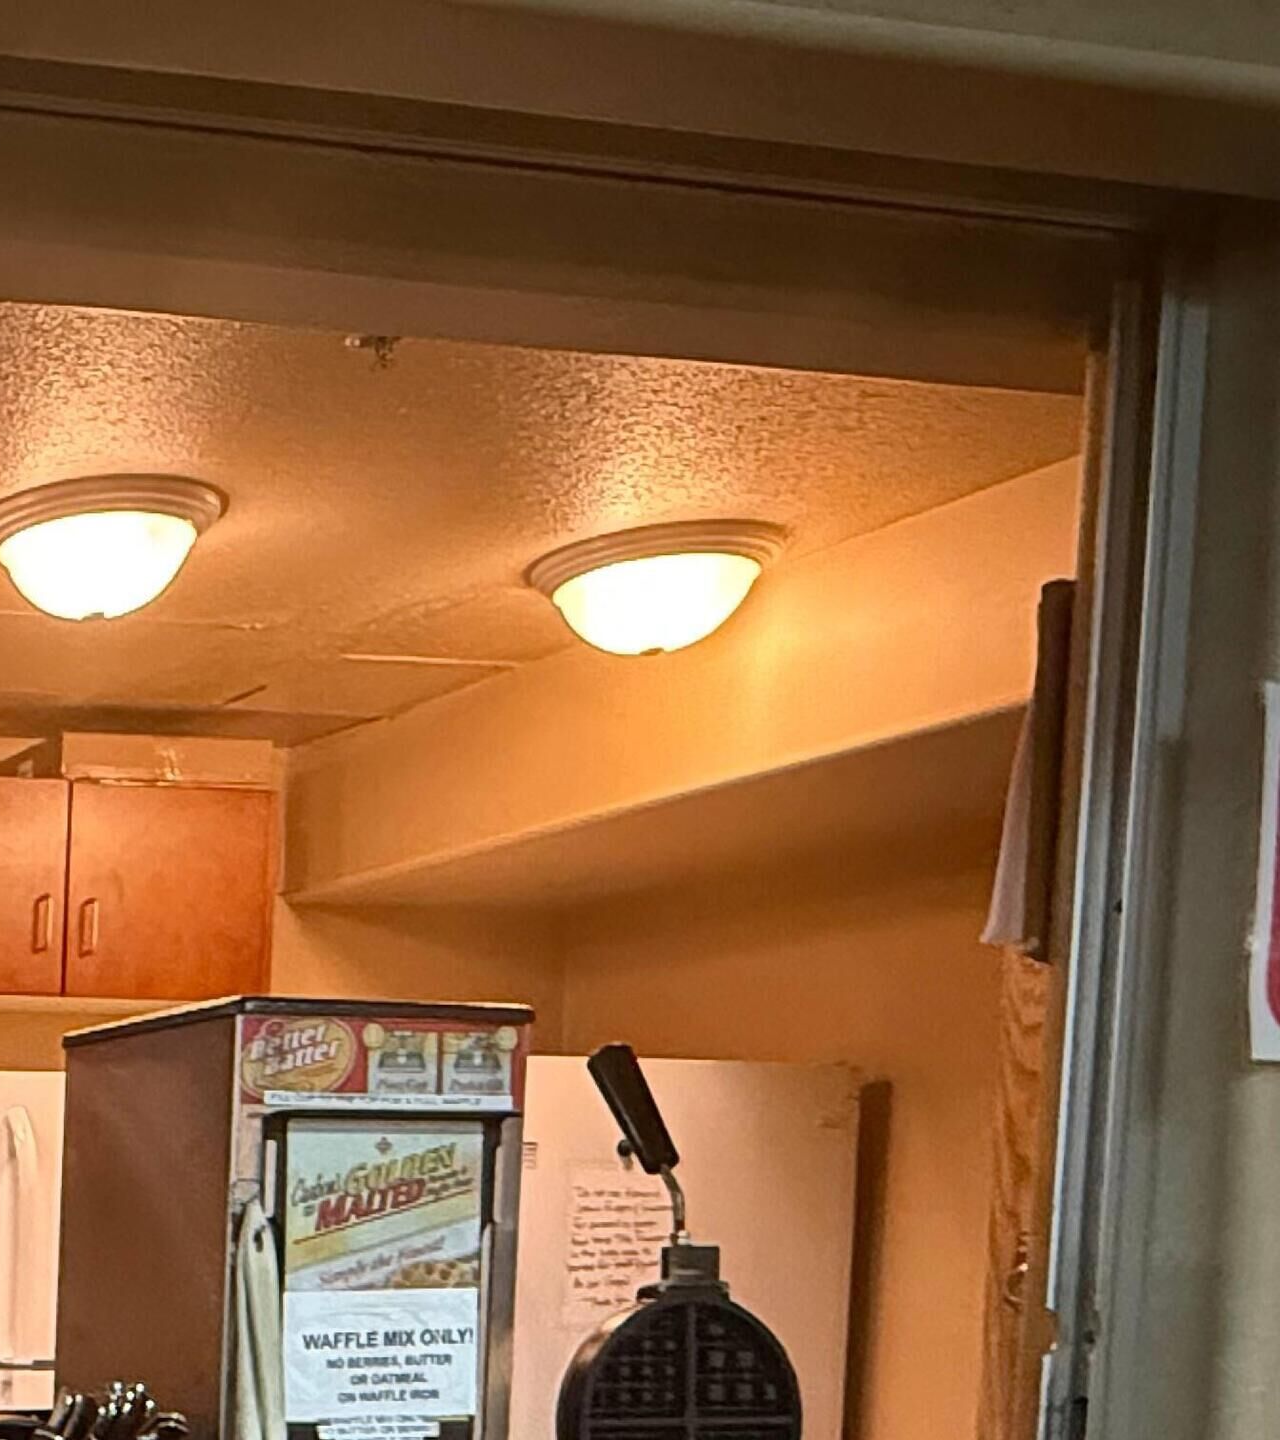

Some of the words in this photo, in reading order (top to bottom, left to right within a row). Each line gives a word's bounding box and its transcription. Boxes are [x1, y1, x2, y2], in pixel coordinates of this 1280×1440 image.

[314, 1176, 427, 1232] MALTED
[302, 1331, 378, 1349] WAFFLE
[383, 1329, 416, 1347] MIX
[420, 1327, 473, 1346] ONLY!
[326, 1358, 344, 1368] NO
[405, 1354, 452, 1366] BUTTER
[350, 1374, 368, 1385] OR
[371, 1372, 428, 1385] OATMEAL
[338, 1392, 356, 1403] ON
[358, 1390, 407, 1402] WAFFLE
[410, 1389, 439, 1399] IRON
